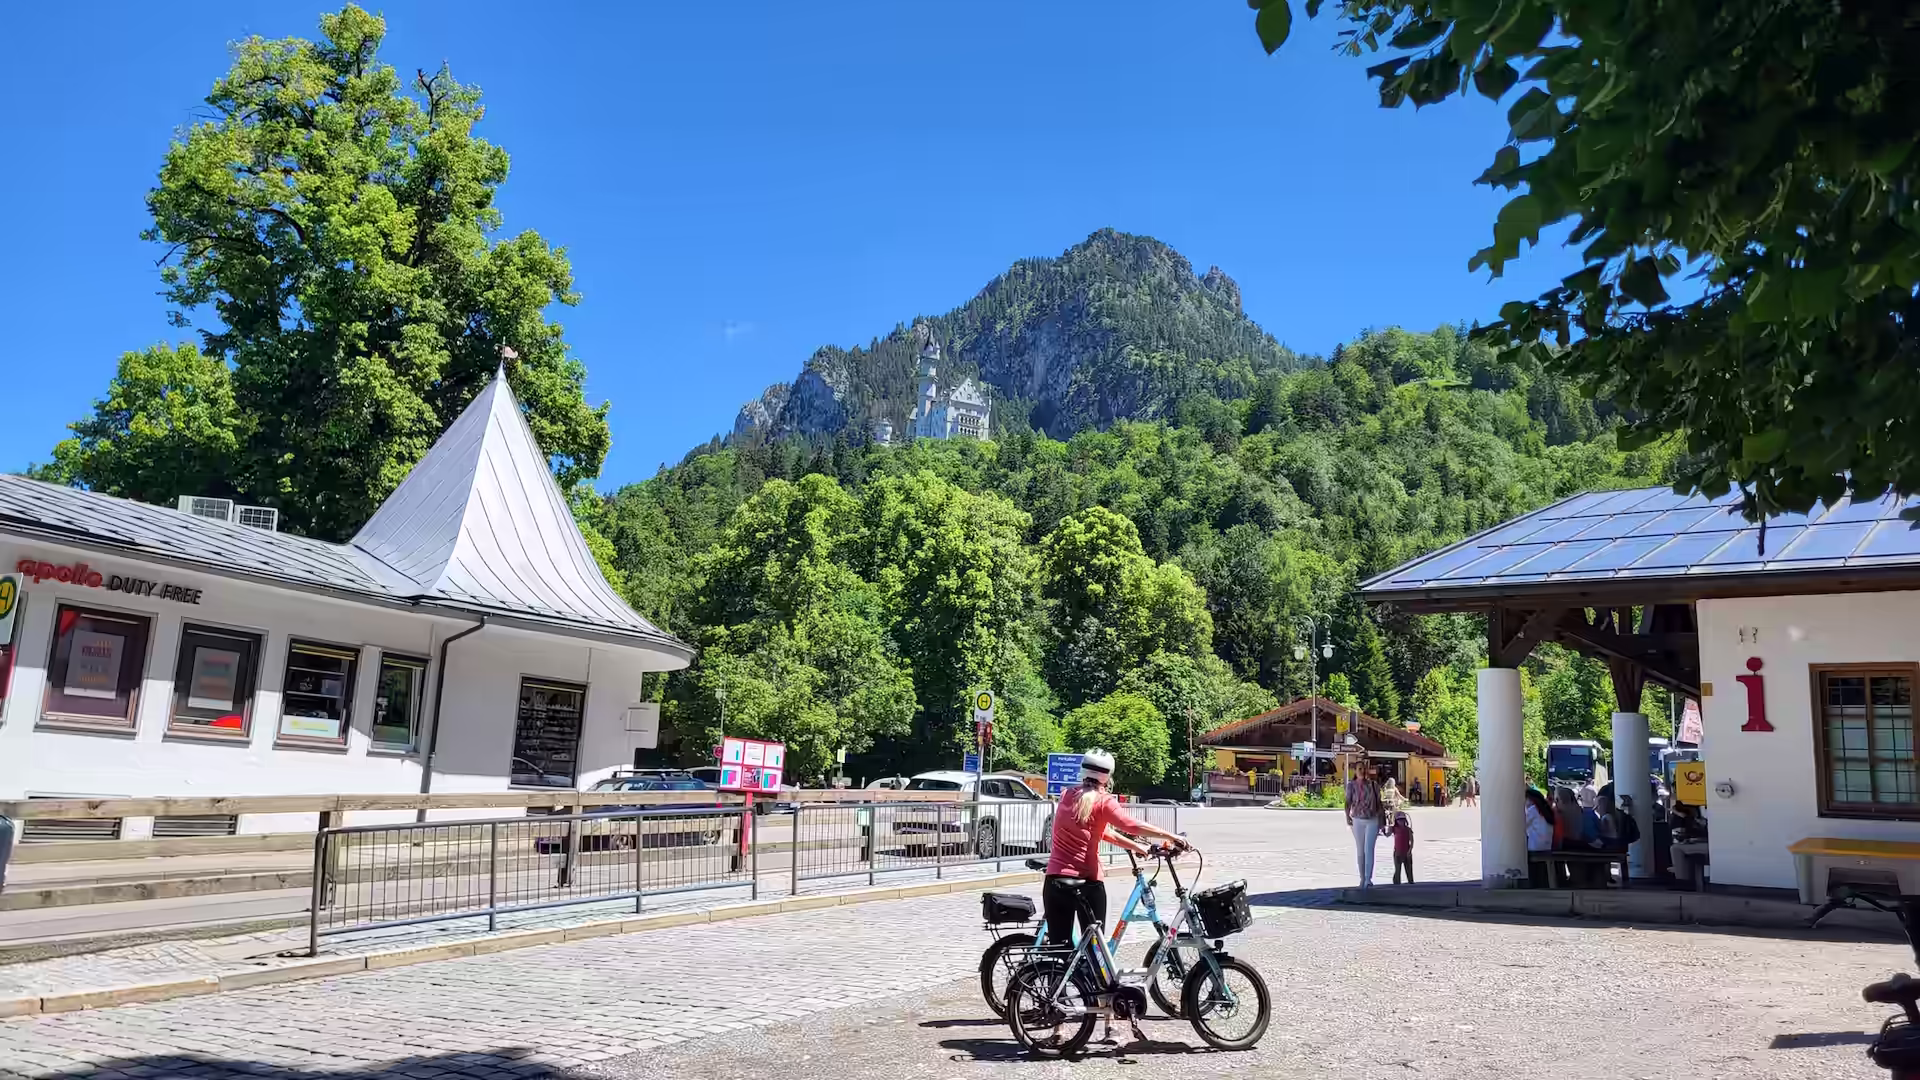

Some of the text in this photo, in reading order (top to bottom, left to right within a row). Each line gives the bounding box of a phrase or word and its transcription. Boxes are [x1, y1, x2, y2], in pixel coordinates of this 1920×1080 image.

[17, 559, 203, 605] apollo DUTY FREE
[980, 696, 988, 707] H
